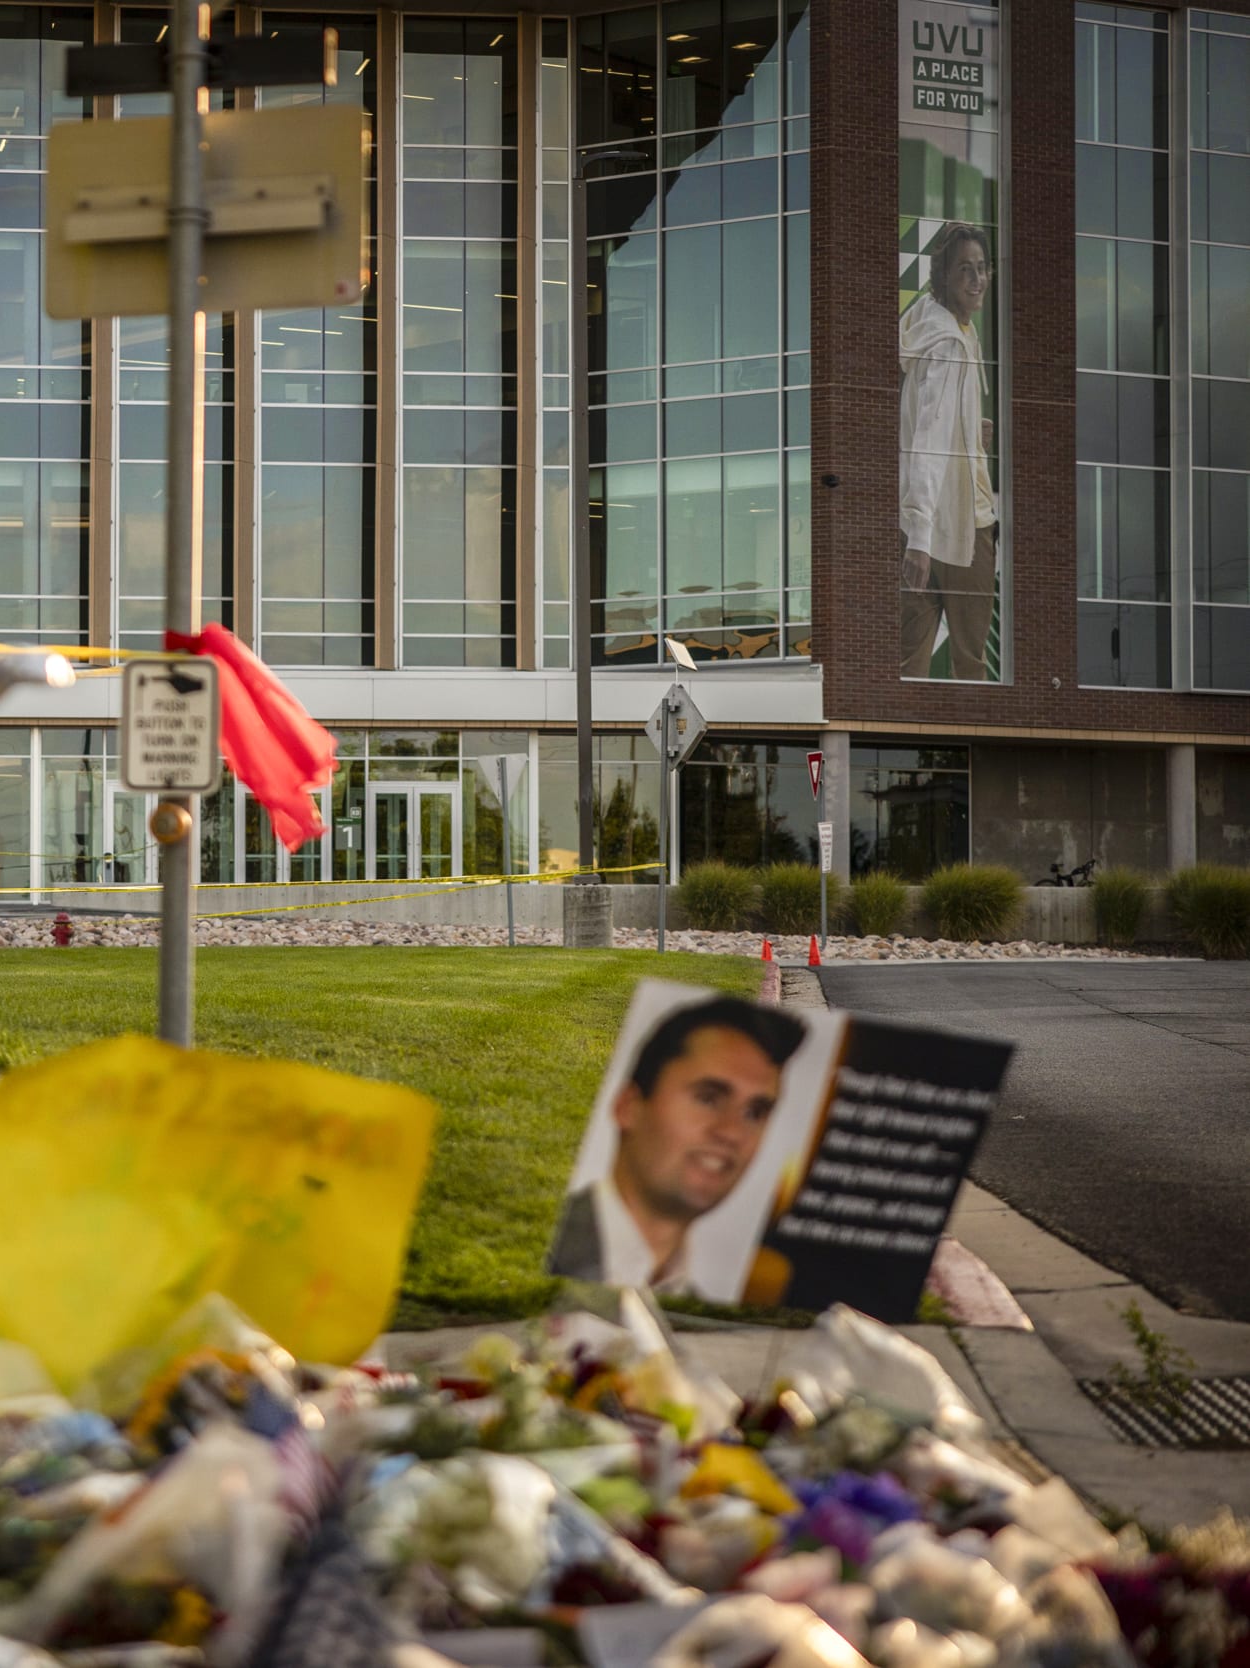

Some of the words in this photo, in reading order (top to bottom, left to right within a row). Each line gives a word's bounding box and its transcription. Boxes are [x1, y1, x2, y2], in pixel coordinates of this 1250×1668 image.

[913, 20, 983, 57] UVU
[917, 61, 927, 77] A
[932, 62, 979, 82] PLACE
[917, 89, 945, 107] FOR
[950, 93, 979, 111] YOU
[136, 716, 185, 729] BUTTON
[342, 826, 353, 848] 1
